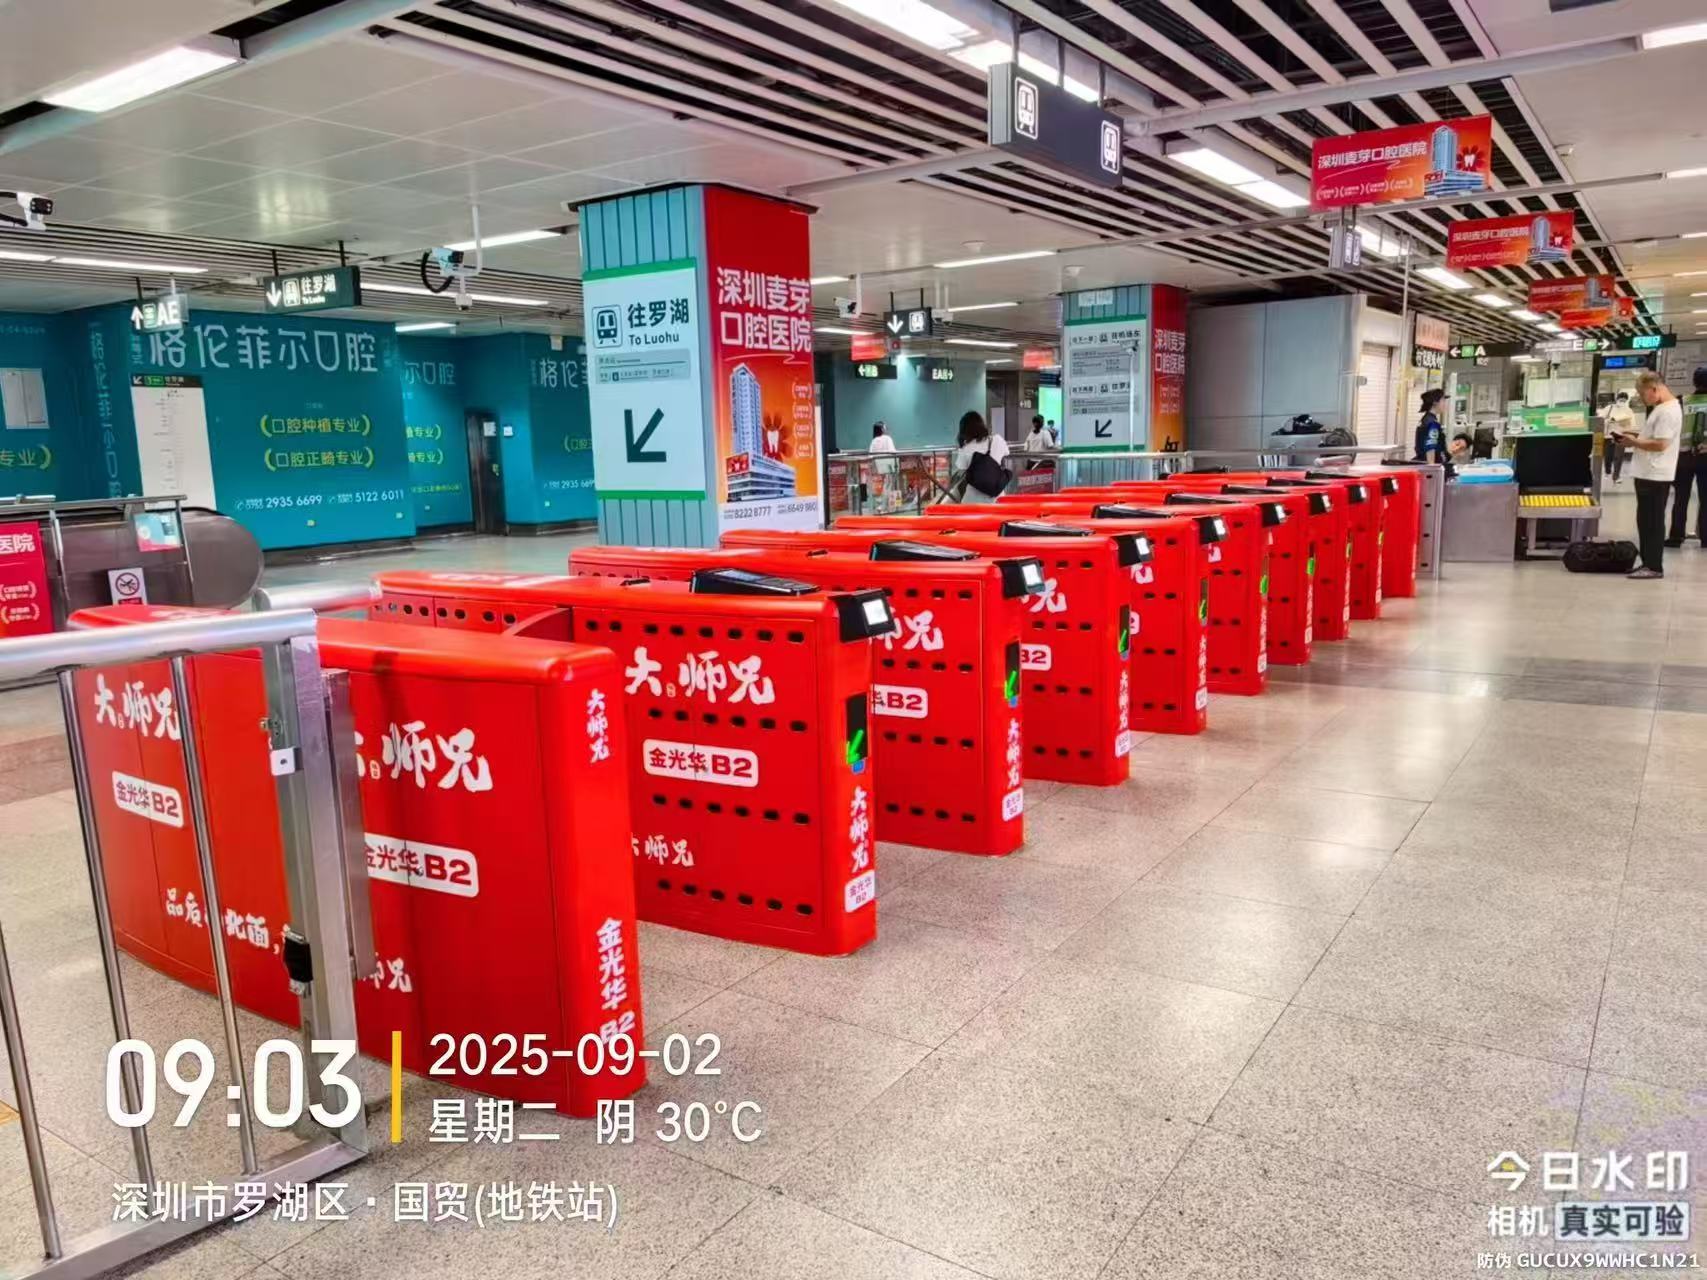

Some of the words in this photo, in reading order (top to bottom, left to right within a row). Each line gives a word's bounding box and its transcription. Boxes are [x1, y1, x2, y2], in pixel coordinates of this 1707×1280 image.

[1318, 141, 1427, 169] 深圳麦芽口腔医院
[301, 274, 336, 294] 往罗湖
[717, 266, 811, 314] 深圳麦芽
[157, 302, 181, 325] AE
[627, 298, 690, 329] 往罗湖
[629, 334, 641, 346] To
[643, 332, 680, 346] Luohu
[720, 311, 812, 353] 口腔医院
[1573, 340, 1584, 350] E
[149, 324, 377, 373] 格伦菲尔口腔
[1475, 345, 1486, 356] A
[266, 496, 293, 509] 2935
[296, 495, 322, 507] 6699
[355, 491, 378, 503] 5122
[381, 489, 404, 501] 6011
[624, 647, 776, 705] 大师兄
[93, 672, 181, 741] 大师兄
[587, 688, 610, 764] 大师兄
[649, 748, 753, 778] 金光华B2
[115, 780, 180, 819] 金光华B2
